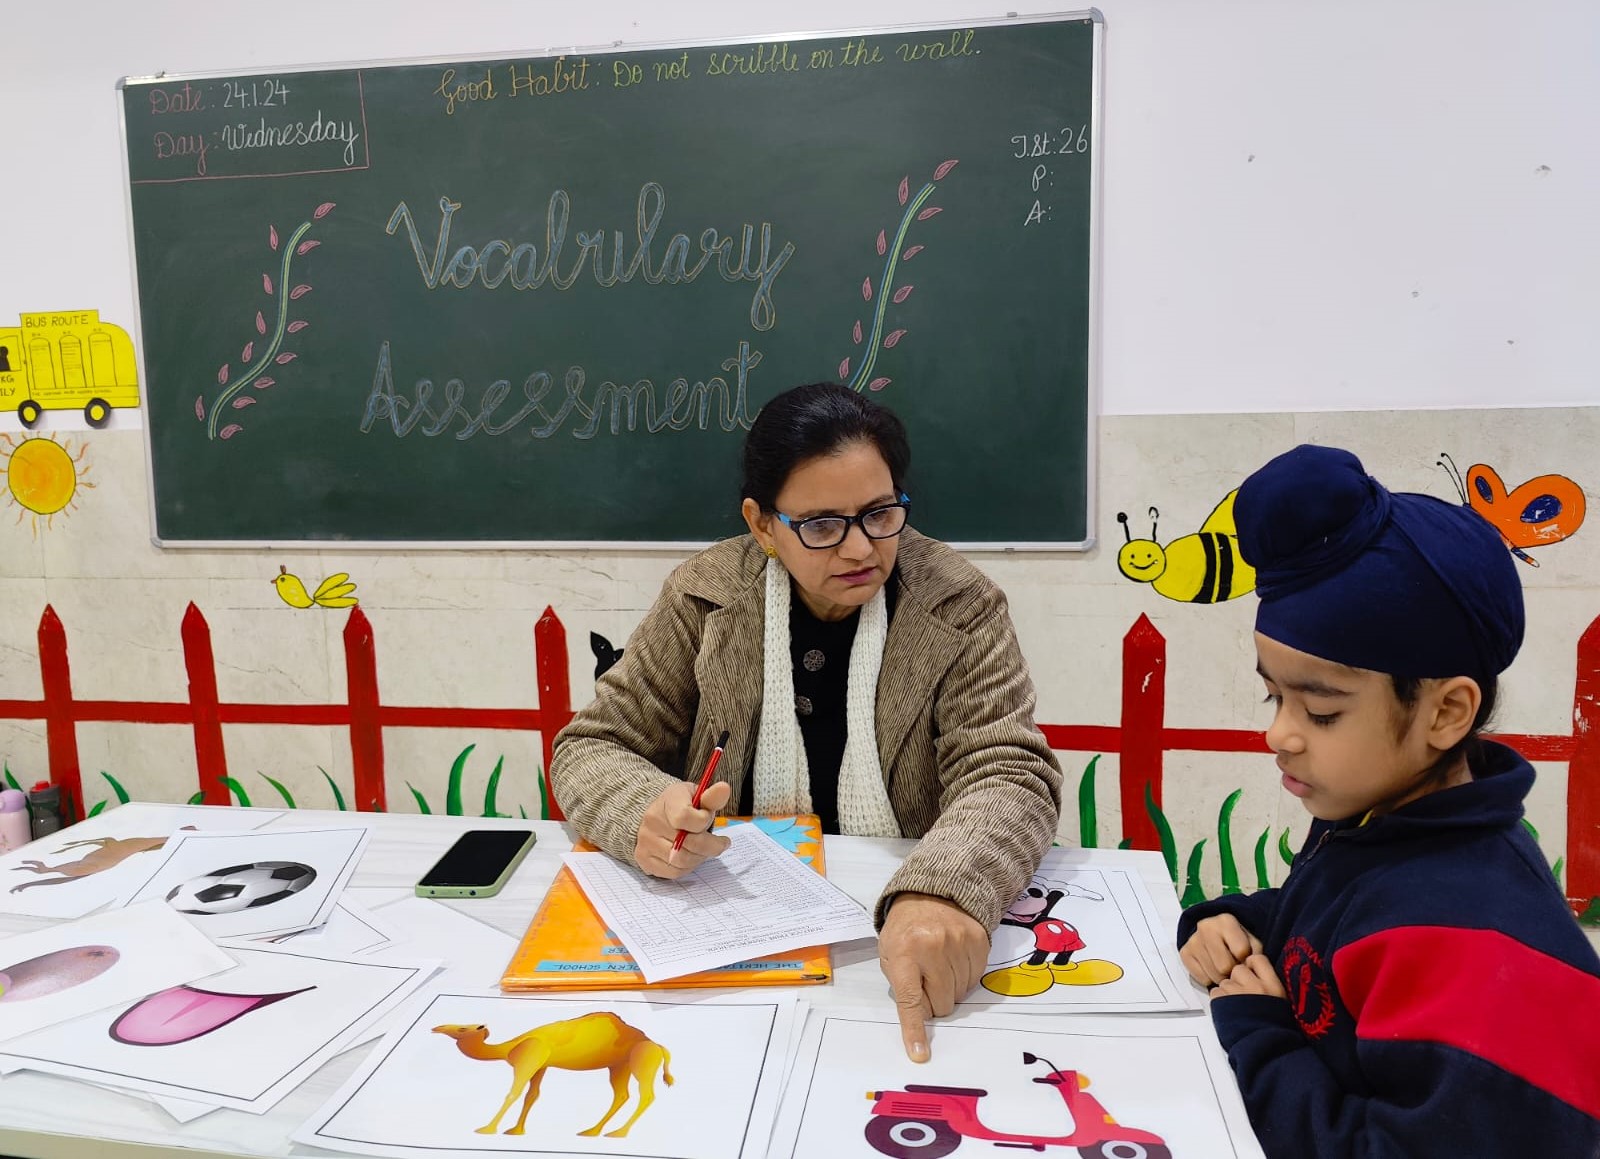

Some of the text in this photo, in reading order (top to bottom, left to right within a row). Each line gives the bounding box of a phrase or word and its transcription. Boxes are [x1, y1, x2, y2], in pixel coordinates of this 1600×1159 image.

[223, 79, 291, 109] 24.1.24
[433, 68, 498, 115] Good
[613, 60, 643, 87] Do
[652, 52, 691, 82] not
[706, 42, 800, 76] scribble
[806, 48, 835, 70] on
[839, 38, 885, 67] the
[896, 29, 981, 62] wall.
[222, 110, 359, 165] Wednesday
[25, 314, 89, 328] BUS ROUTE
[359, 340, 764, 441] Assessment
